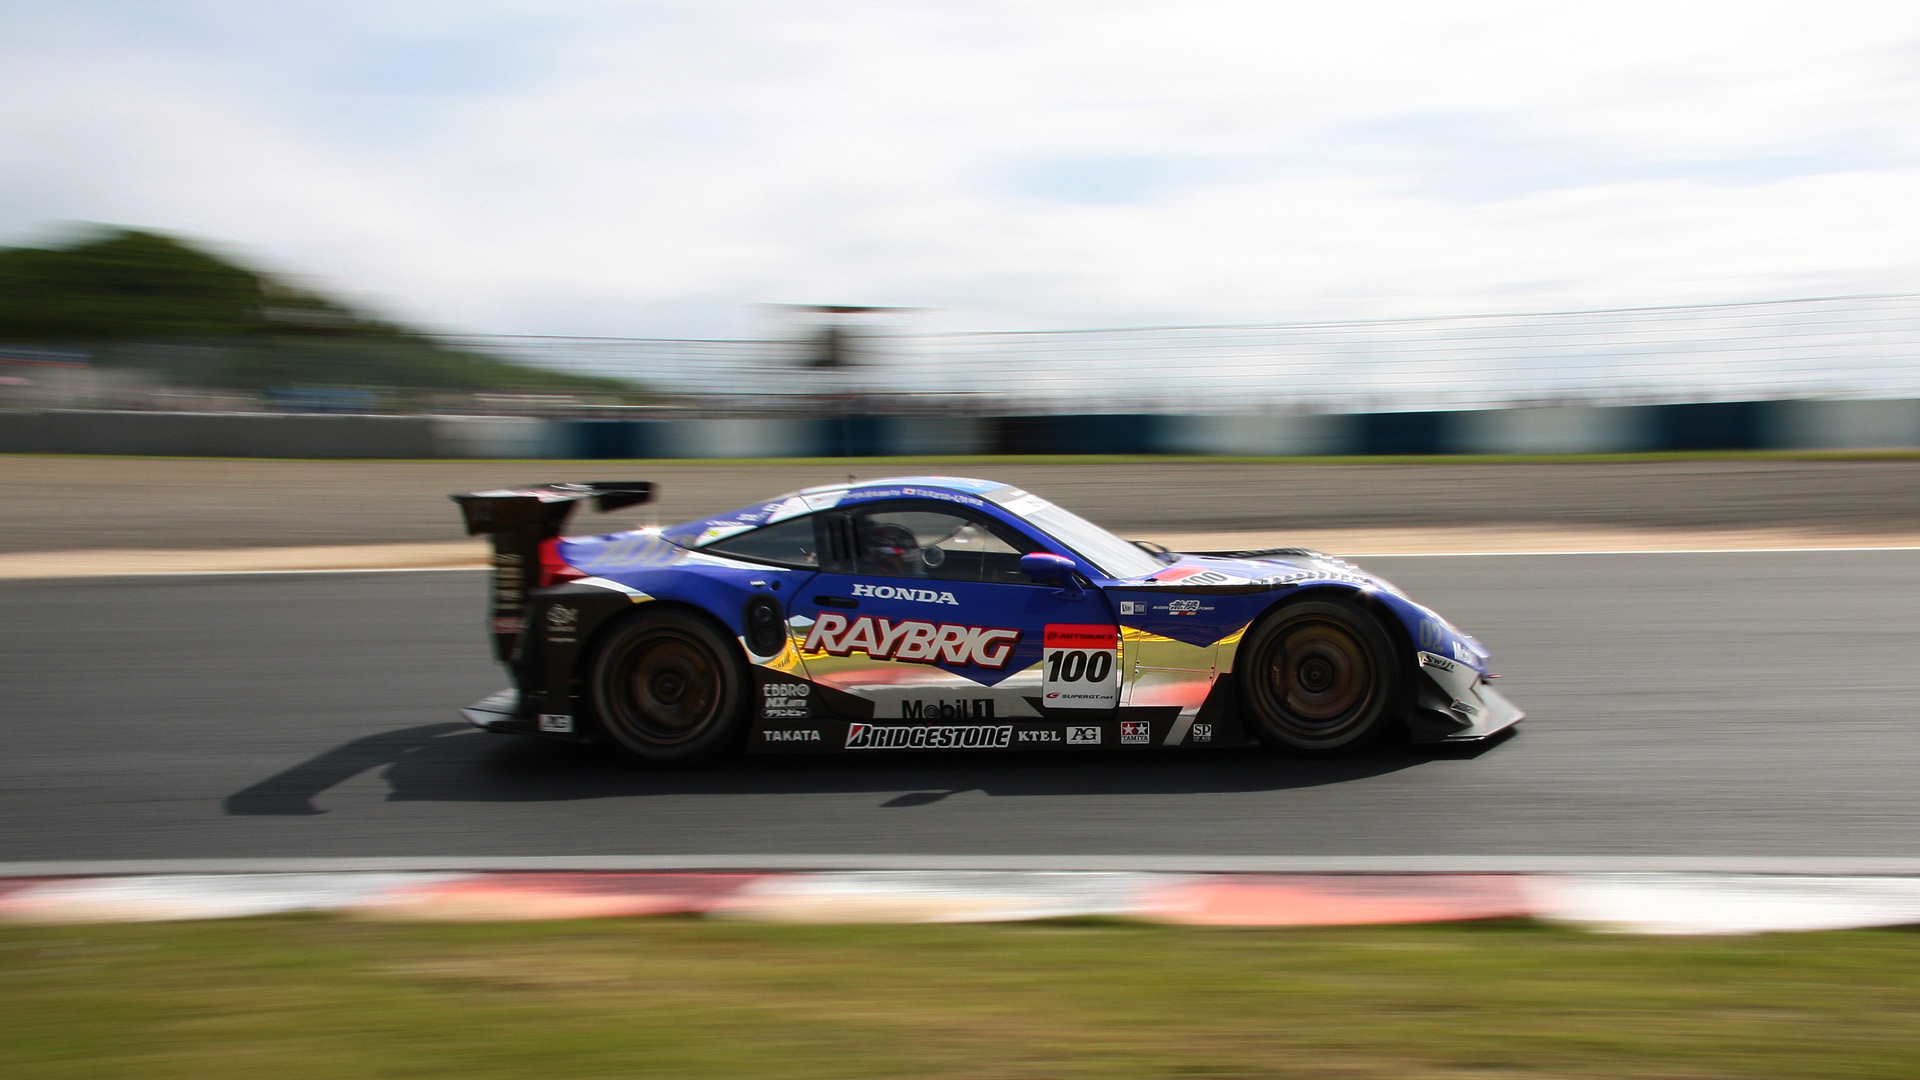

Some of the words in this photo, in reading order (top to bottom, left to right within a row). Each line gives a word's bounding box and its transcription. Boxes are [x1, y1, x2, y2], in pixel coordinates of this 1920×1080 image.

[851, 583, 959, 605] HONDA
[803, 612, 1021, 668] RAYBRIG
[1058, 632, 1114, 640] AUTOBACS
[1047, 650, 1112, 683] 100
[1423, 654, 1456, 670] Swift
[763, 683, 810, 697] EBBRO
[902, 699, 967, 718] Mobil
[763, 730, 821, 741] TAKATA
[846, 723, 1013, 748] BRIDGESTONE
[1018, 731, 1061, 741] KTEL
[1071, 728, 1097, 740] AG
[1194, 725, 1210, 736] SP
